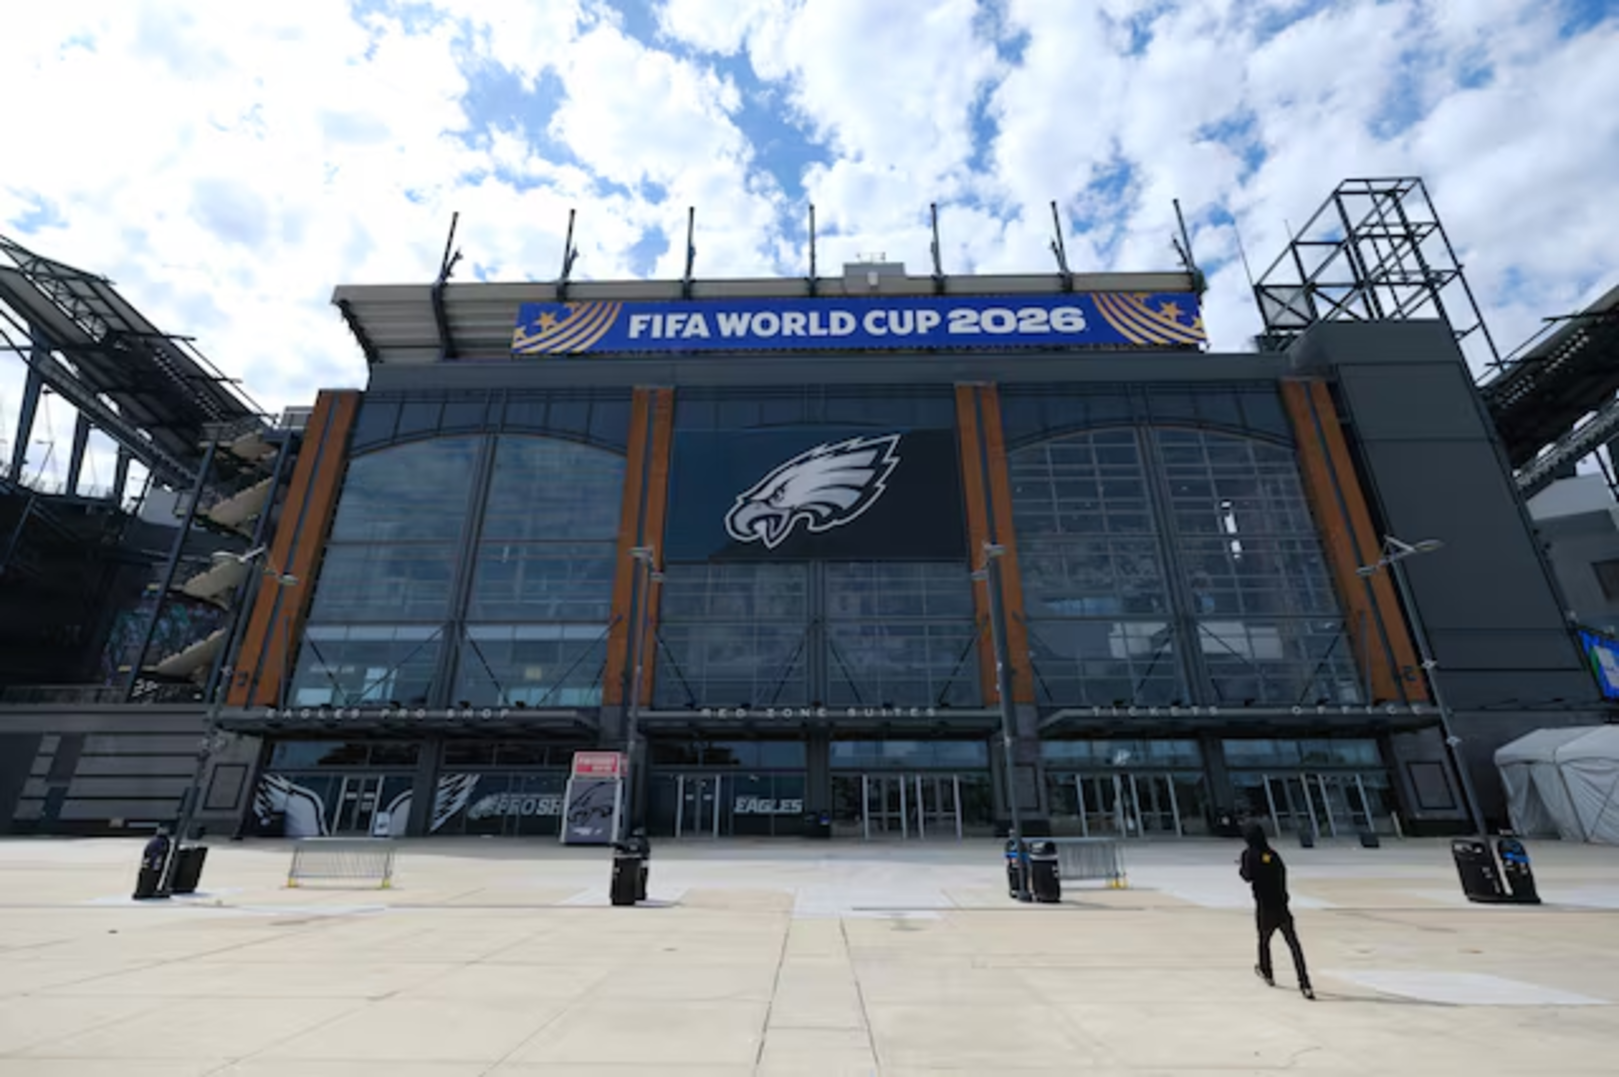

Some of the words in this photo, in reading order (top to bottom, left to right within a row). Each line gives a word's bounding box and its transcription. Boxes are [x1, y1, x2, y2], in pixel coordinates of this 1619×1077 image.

[628, 313, 710, 339] FIFA
[716, 310, 857, 338] WORLD
[863, 310, 941, 335] CUP
[948, 307, 1087, 334] 2026
[265, 708, 360, 719] EAGLES
[380, 708, 427, 719] PRO
[446, 708, 510, 719] SHOP
[700, 707, 748, 719] RED
[766, 707, 828, 719] ZONE
[846, 707, 936, 718] SUITES
[495, 798, 537, 816] PRO
[536, 798, 567, 816] SH
[733, 795, 804, 814] EAGLES
